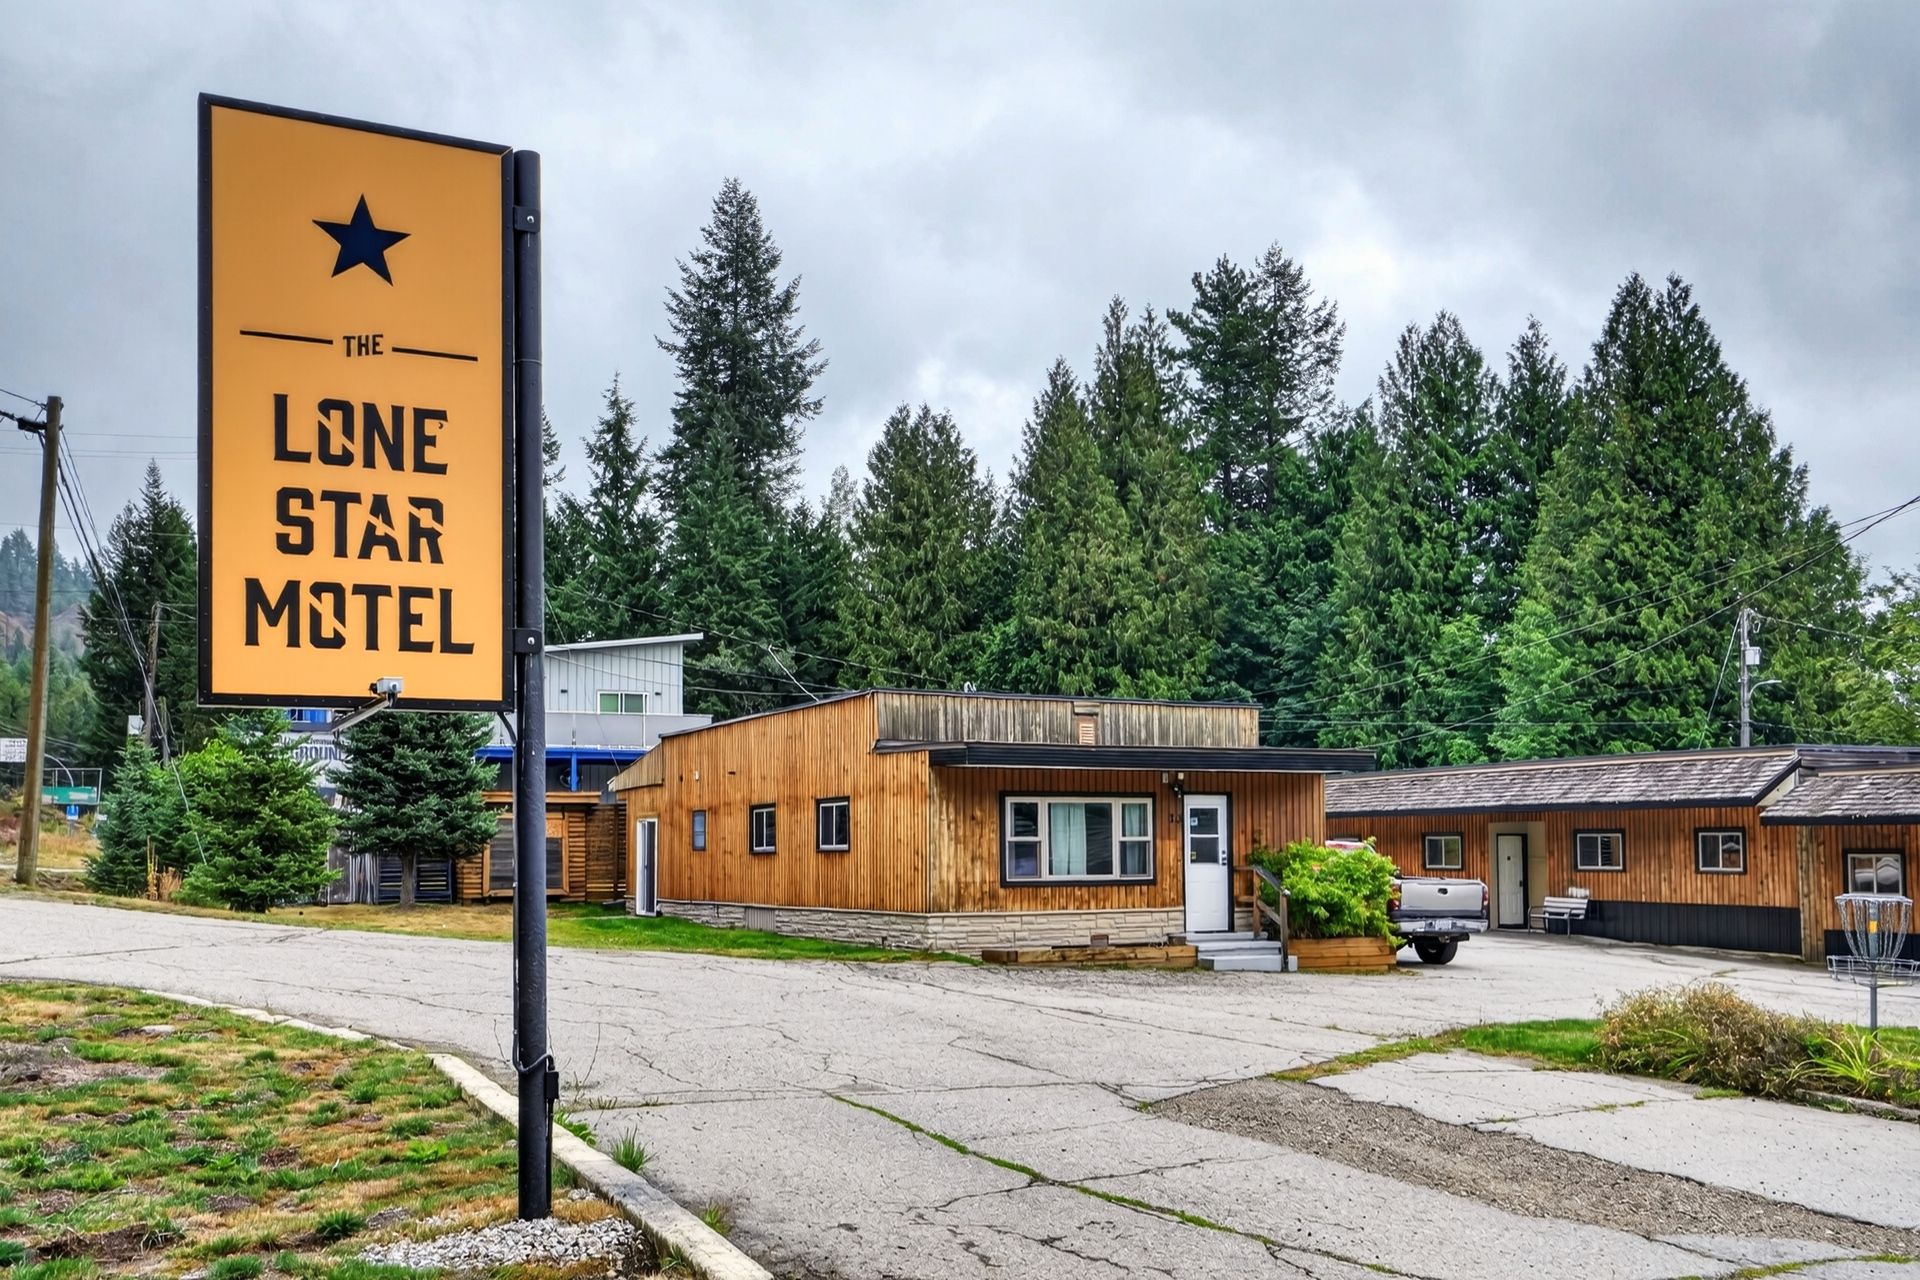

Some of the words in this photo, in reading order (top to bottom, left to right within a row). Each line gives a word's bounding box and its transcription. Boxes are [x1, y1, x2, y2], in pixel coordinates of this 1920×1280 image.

[342, 334, 384, 357] THE
[273, 393, 448, 475] LONE
[275, 487, 443, 564] STAR
[244, 577, 475, 655] MOTEL
